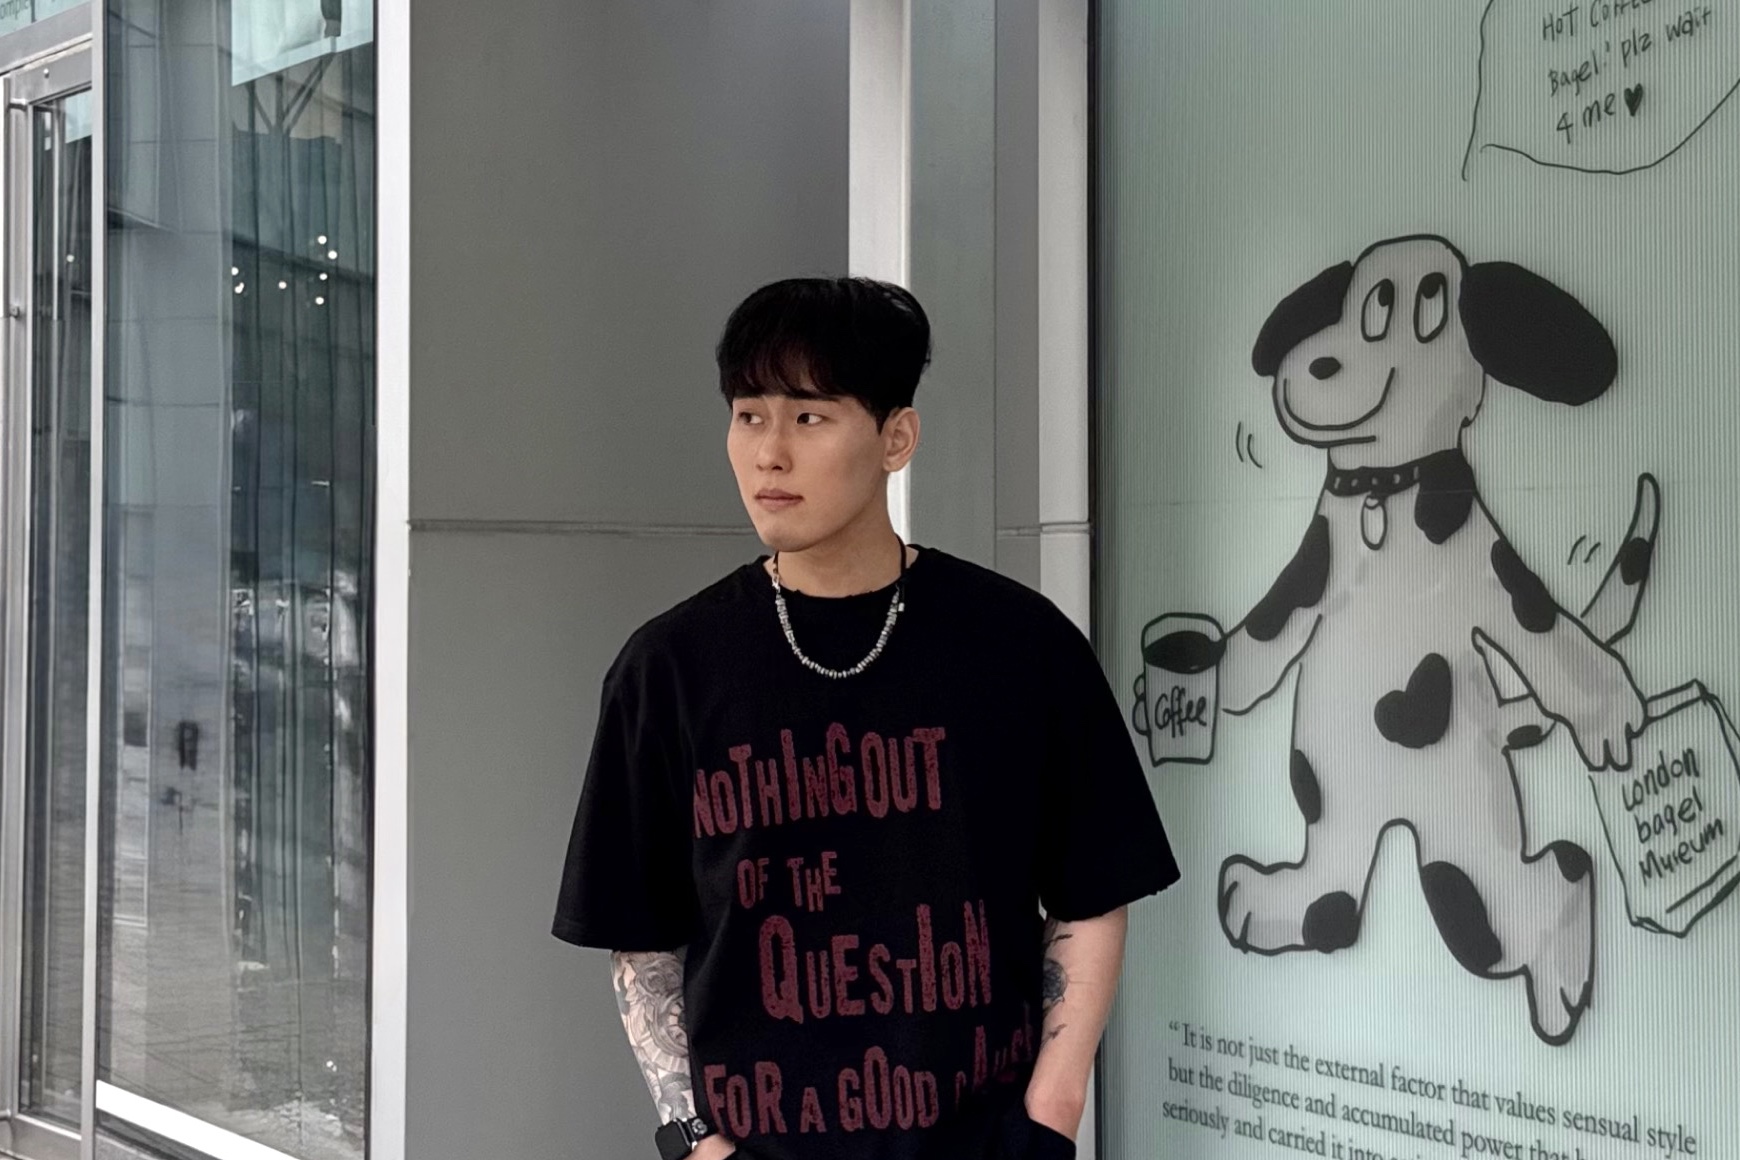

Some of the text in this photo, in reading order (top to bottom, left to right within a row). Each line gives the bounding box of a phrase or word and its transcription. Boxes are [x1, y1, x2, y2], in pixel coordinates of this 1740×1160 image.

[1556, 92, 1615, 144] 4 me
[1155, 685, 1207, 738] Coffee
[1622, 748, 1699, 811] London
[737, 851, 841, 911] OF THE
[759, 899, 991, 1024] QUESTION
[704, 1061, 788, 1139] FOR
[800, 1086, 827, 1133] A
[838, 1046, 940, 1132] GOOD
[1168, 1056, 1195, 1086] but
[1199, 1066, 1223, 1092] the
[1227, 1071, 1299, 1110] diligence
[1304, 1093, 1337, 1119] and
[1342, 1104, 1455, 1147] accumulated
[1201, 1026, 1213, 1052] is
[1217, 1037, 1244, 1059] not
[1249, 1036, 1279, 1067] just
[1284, 1044, 1310, 1072] the
[1315, 1057, 1385, 1089] external
[1391, 1065, 1447, 1101] factor
[1451, 1079, 1490, 1112] that
[1494, 1091, 1556, 1126] values
[1562, 1110, 1640, 1144] sensual
[1646, 1124, 1697, 1160] style
[1162, 1099, 1230, 1140] seriously
[1234, 1116, 1263, 1141] and
[1268, 1127, 1327, 1157] carried
[1331, 1134, 1343, 1160] it
